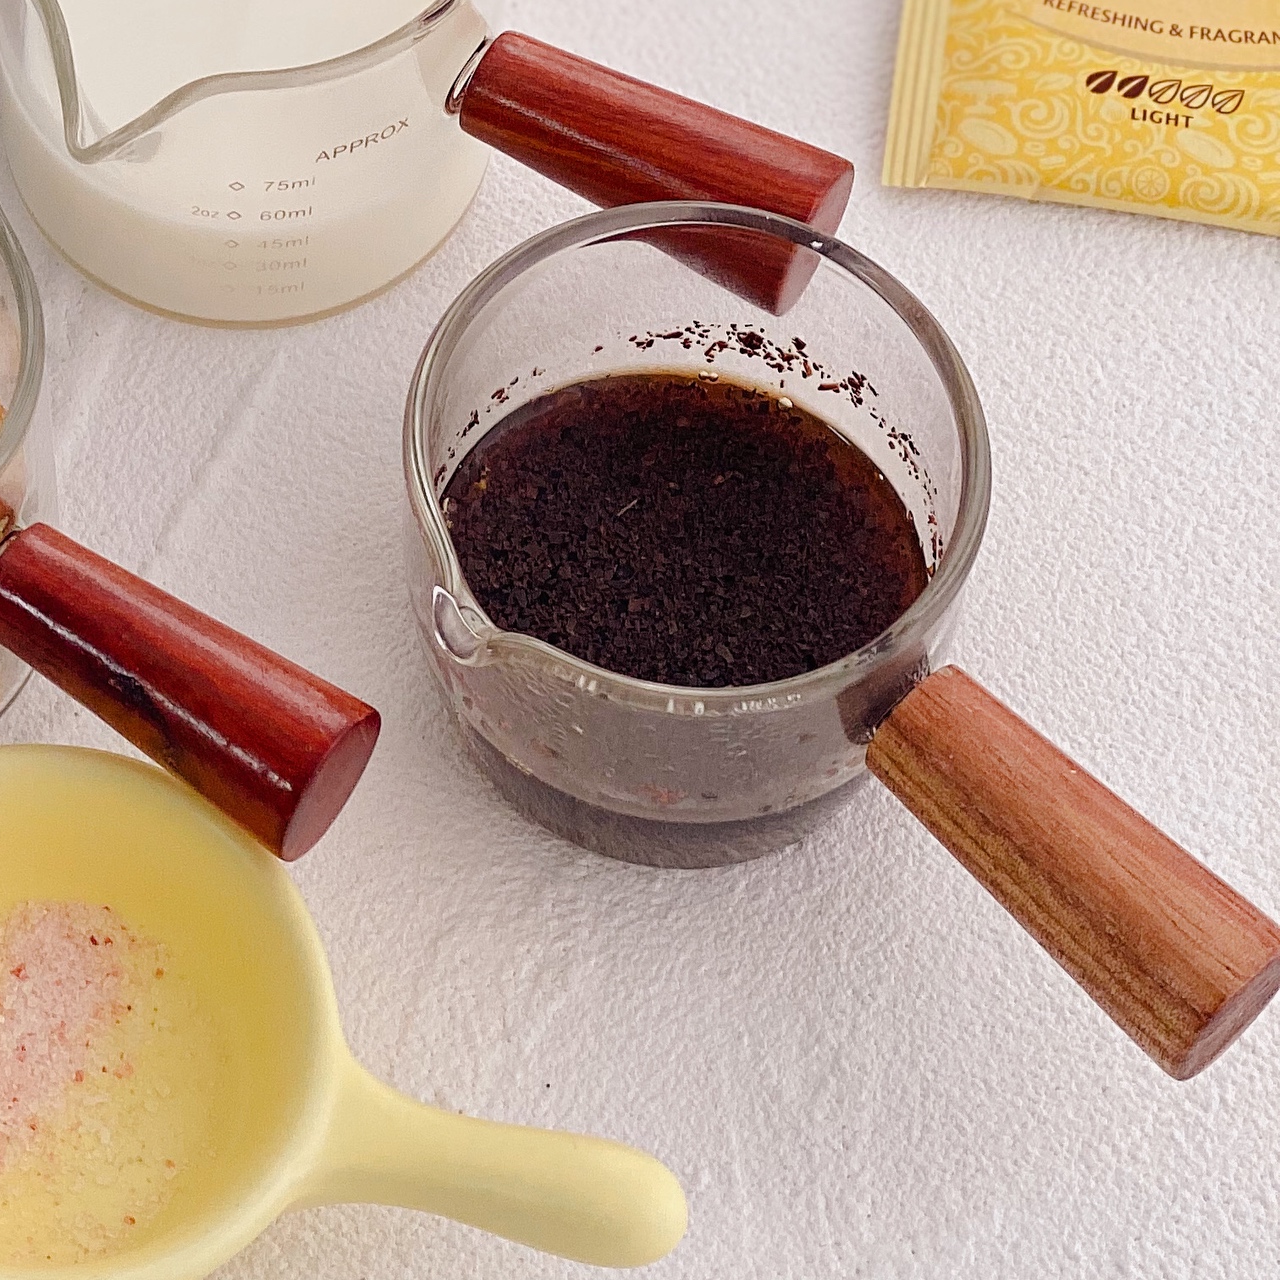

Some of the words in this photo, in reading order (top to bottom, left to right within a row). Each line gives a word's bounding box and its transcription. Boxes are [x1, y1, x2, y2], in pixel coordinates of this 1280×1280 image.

[1169, 23, 1183, 38] &
[1131, 107, 1194, 128] LIGHT
[315, 117, 410, 163] APPROX
[264, 176, 316, 192] 75ml
[191, 206, 220, 219] 2oz
[260, 206, 313, 221] 60ml
